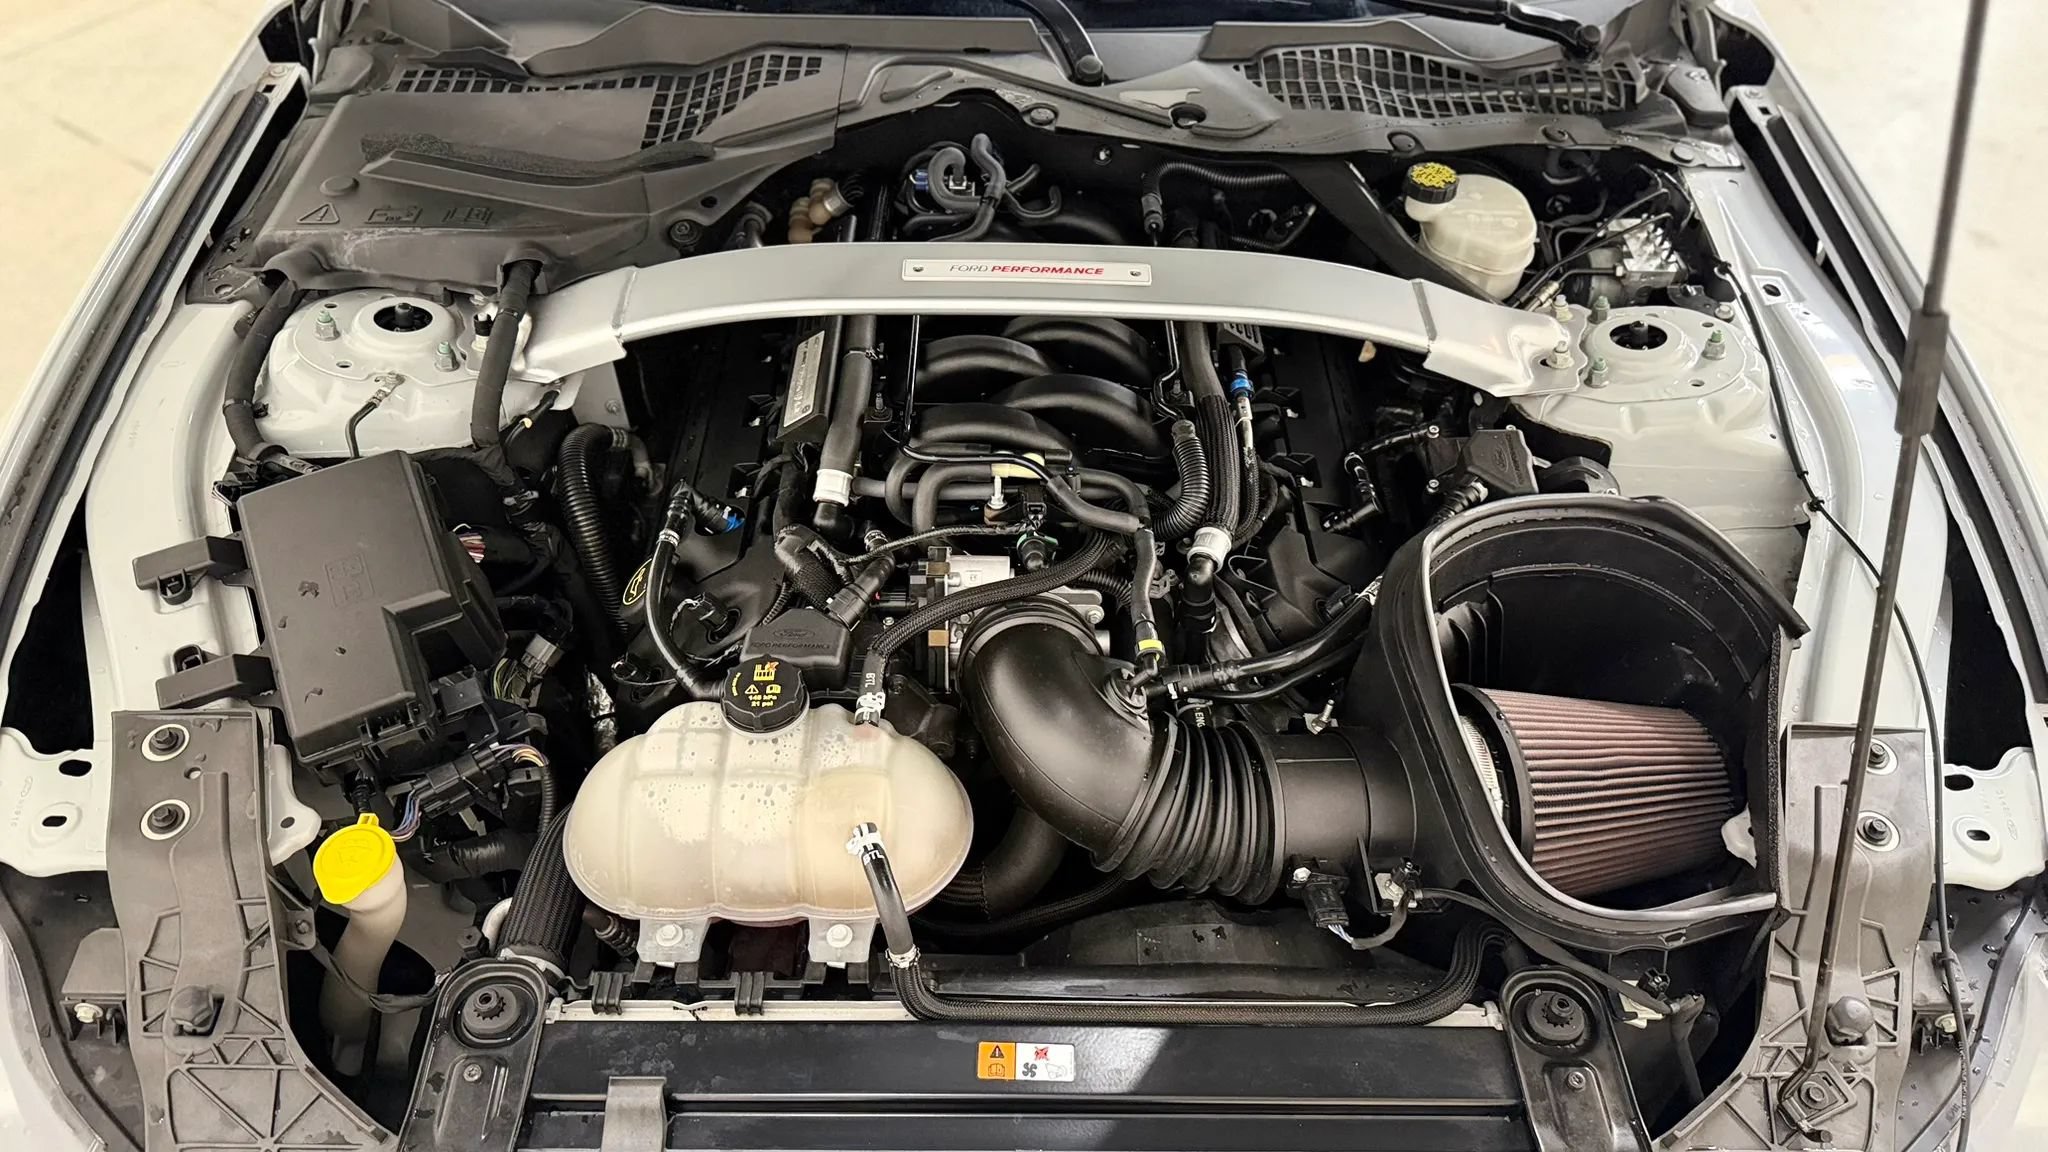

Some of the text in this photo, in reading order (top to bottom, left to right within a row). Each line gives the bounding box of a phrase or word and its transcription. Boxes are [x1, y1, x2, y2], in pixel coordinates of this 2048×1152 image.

[949, 264, 1104, 275] FORD PERFORMANCE
[864, 672, 876, 688] BTL
[1194, 711, 1206, 728] ENG
[862, 850, 885, 866] BTL
